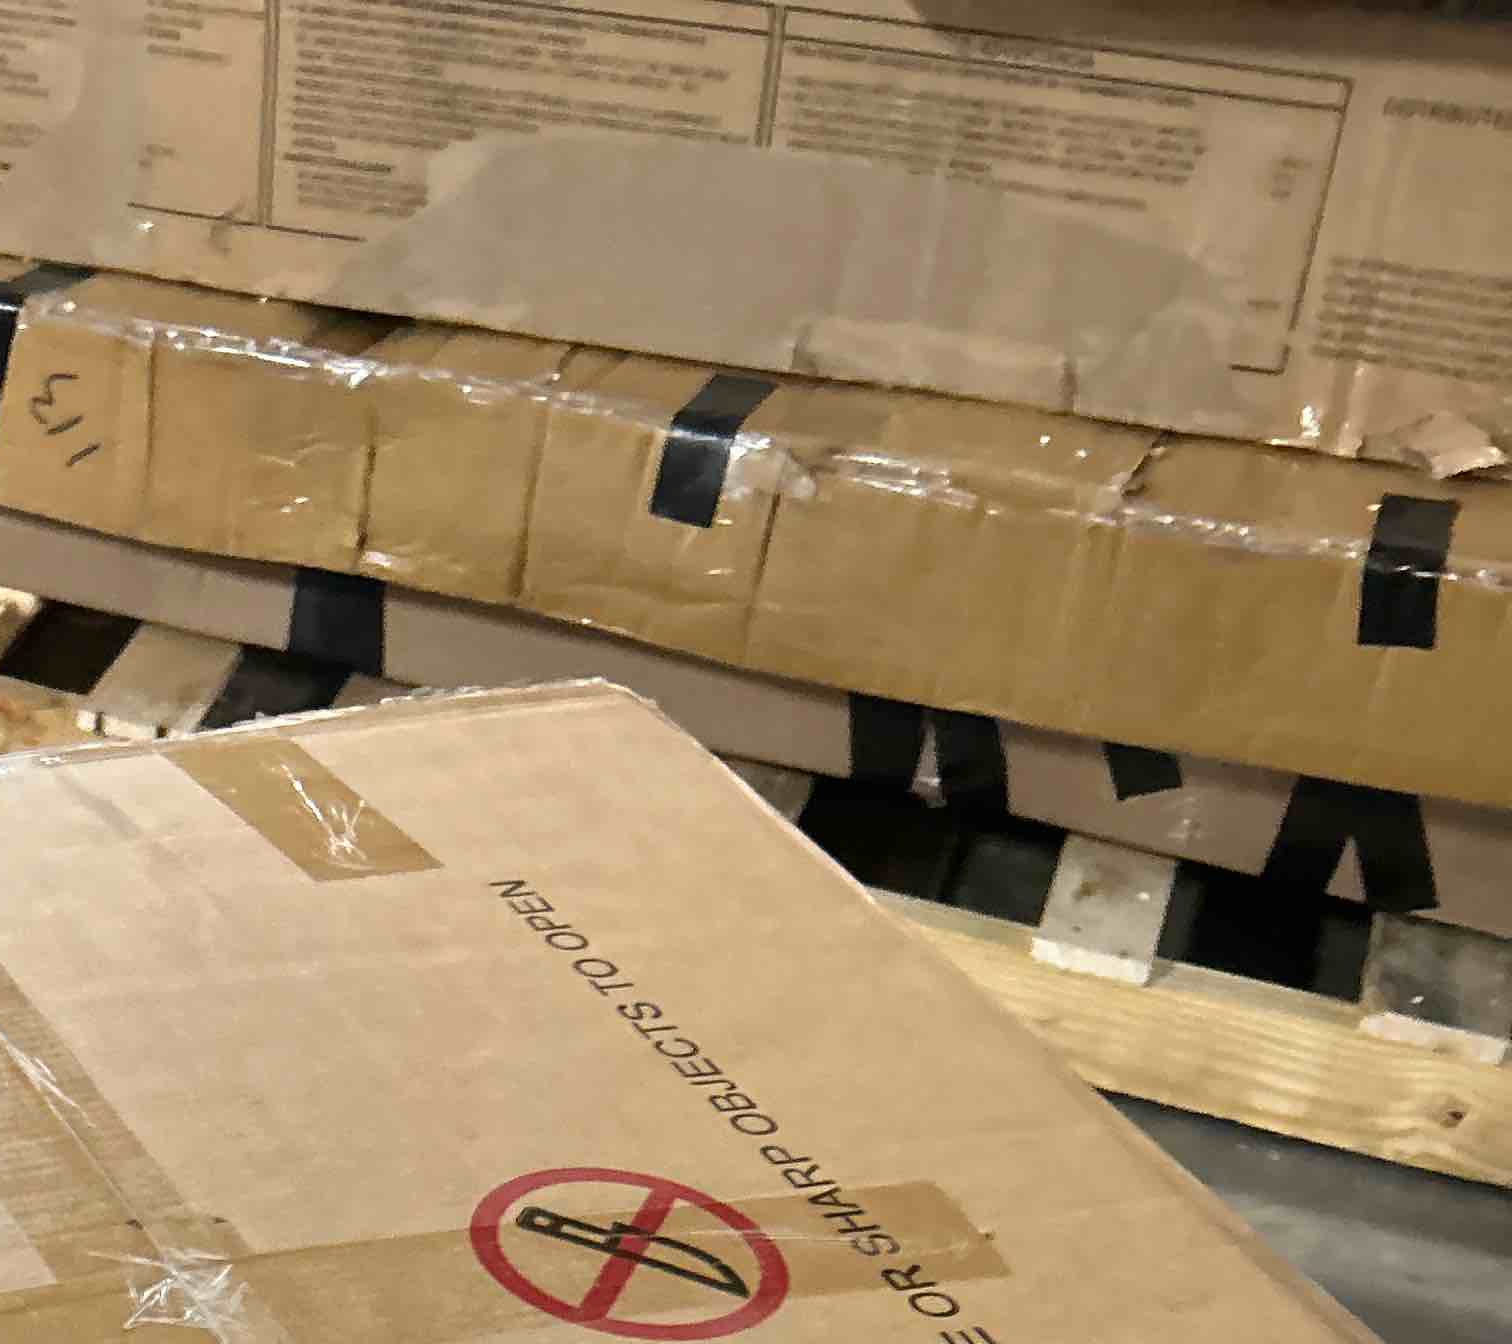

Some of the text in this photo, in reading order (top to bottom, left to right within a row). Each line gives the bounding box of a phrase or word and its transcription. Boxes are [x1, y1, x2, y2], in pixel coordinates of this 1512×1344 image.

[491, 878, 589, 952] OPEN
[574, 958, 635, 1002] TO
[620, 1000, 778, 1138] OBJECTS
[763, 1142, 900, 1259] SHARP
[881, 1265, 960, 1318] OR
